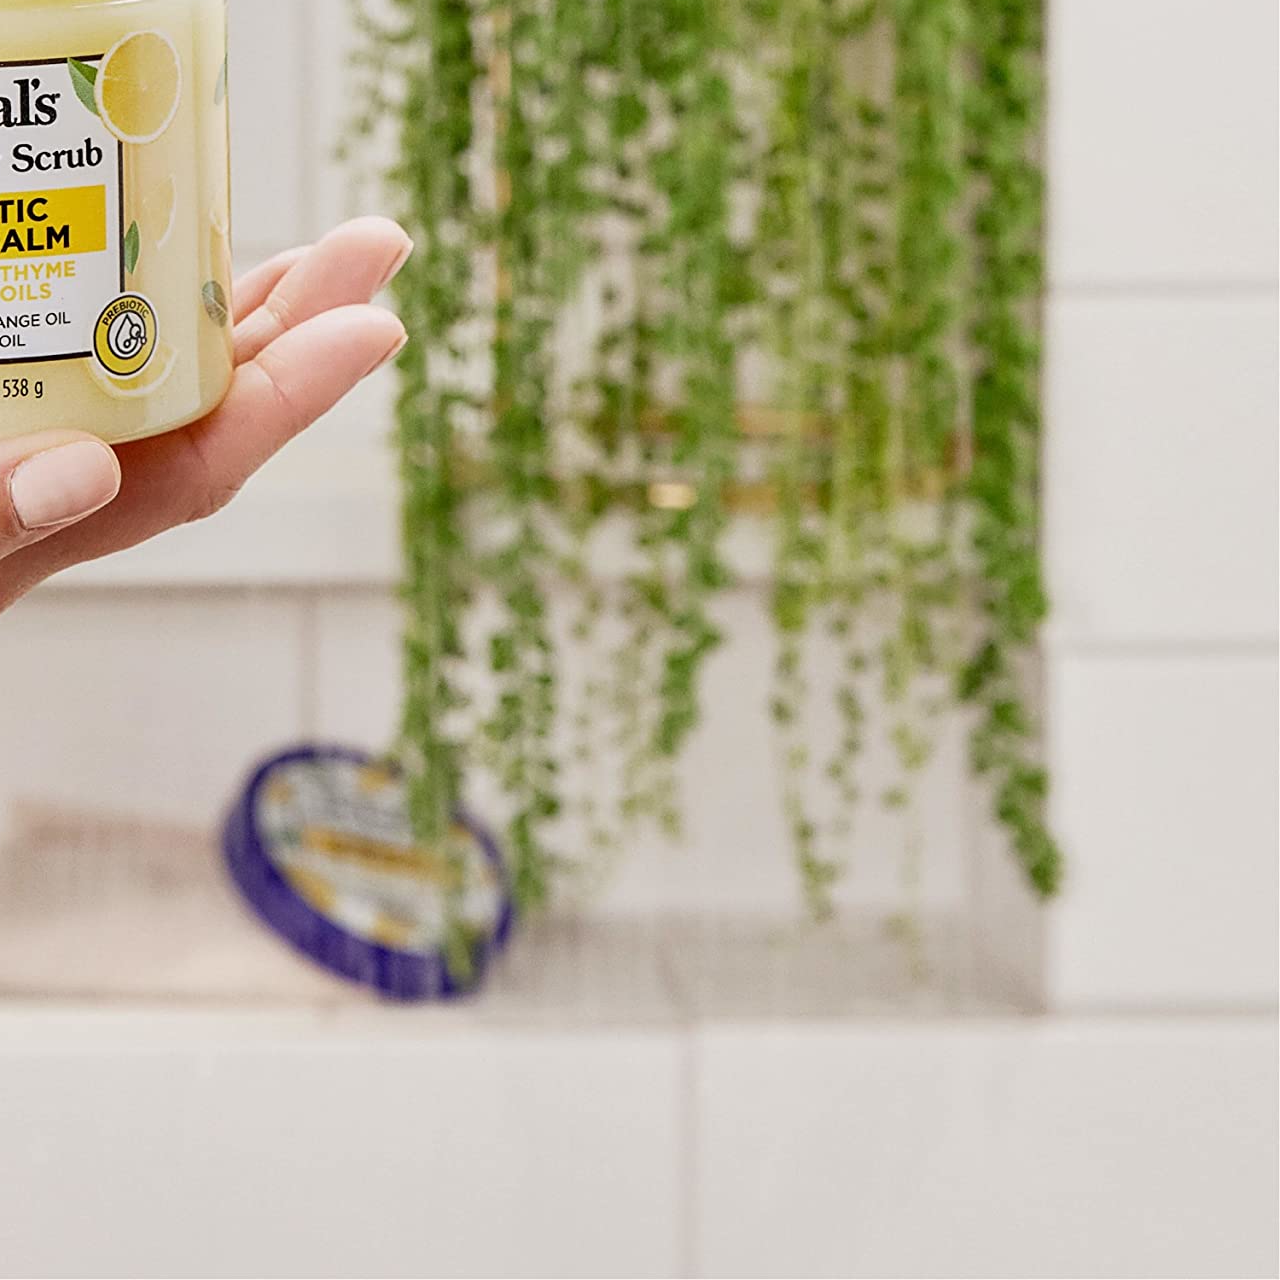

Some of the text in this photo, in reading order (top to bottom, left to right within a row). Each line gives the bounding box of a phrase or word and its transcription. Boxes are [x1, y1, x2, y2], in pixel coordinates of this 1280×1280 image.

[11, 138, 103, 172] Scrub
[0, 283, 52, 301] OILS
[45, 312, 71, 326] OIL
[102, 299, 150, 327] PREBIOTIC
[2, 379, 29, 398] 538
[34, 379, 43, 398] g
